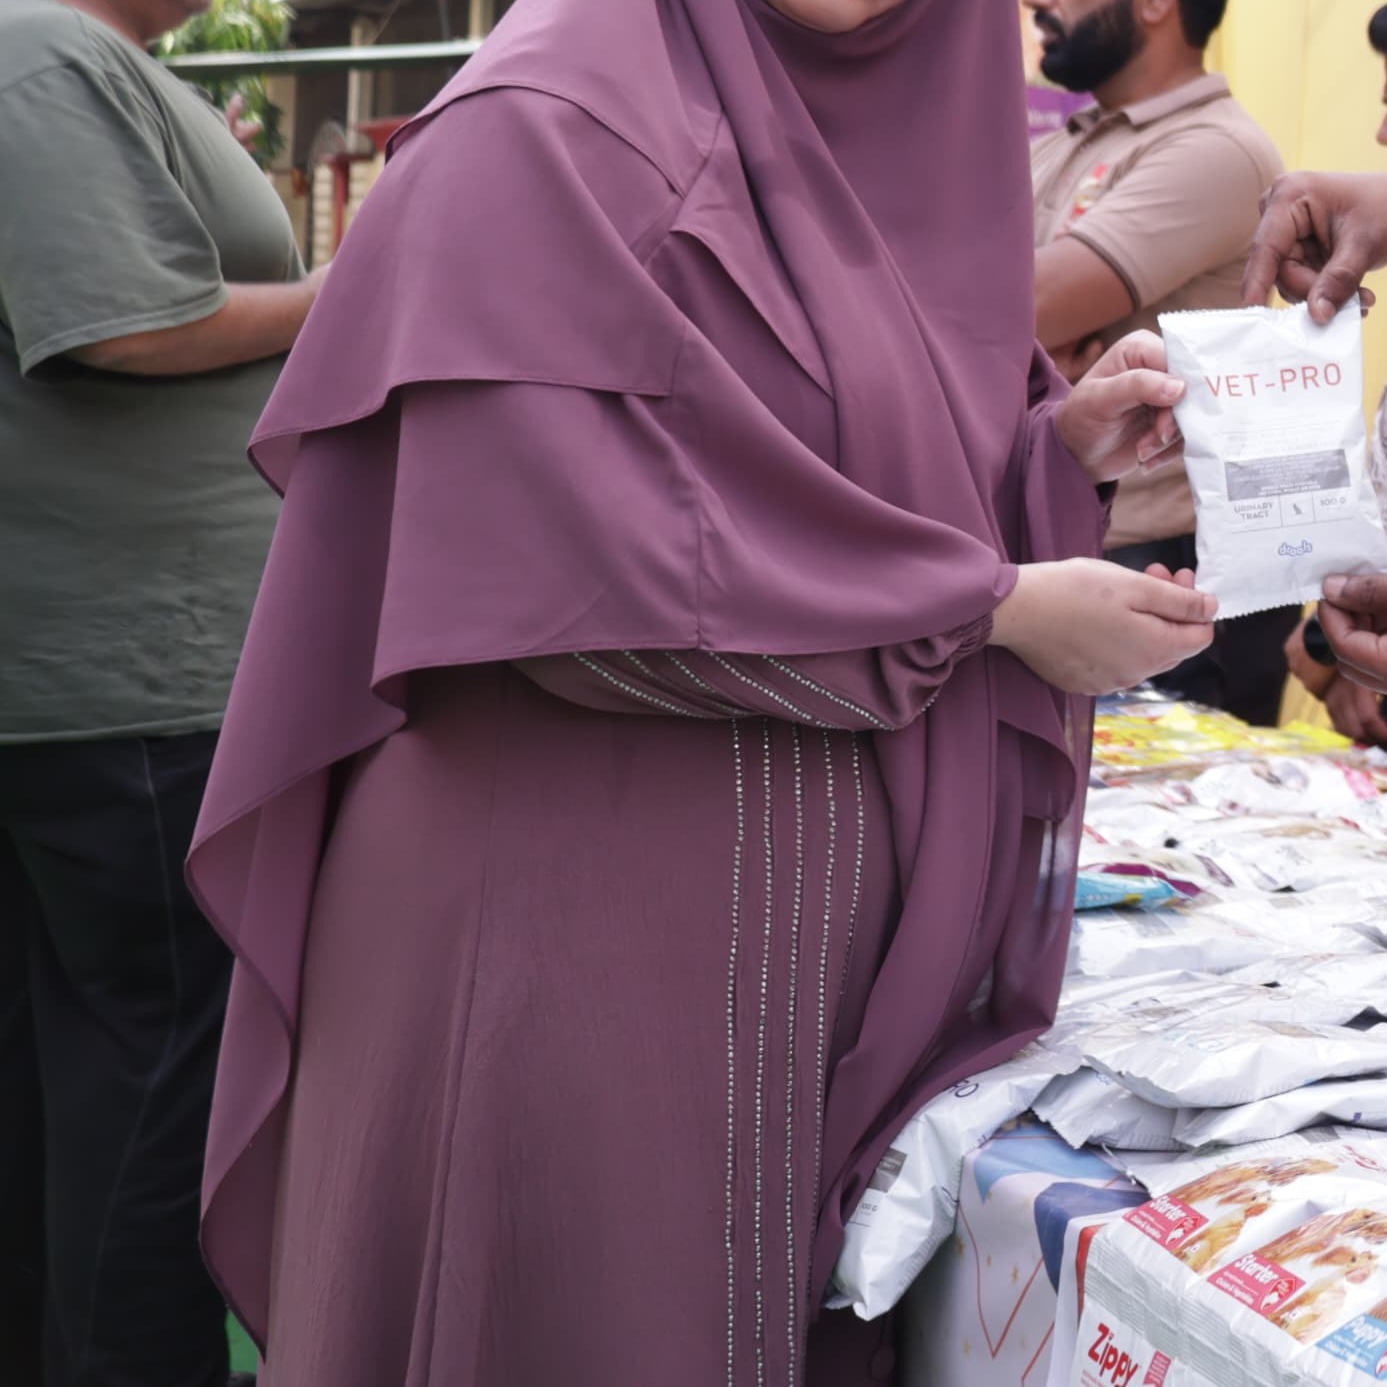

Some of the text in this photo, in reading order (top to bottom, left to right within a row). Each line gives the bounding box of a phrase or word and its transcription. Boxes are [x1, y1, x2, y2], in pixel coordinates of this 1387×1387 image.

[1205, 363, 1342, 398] VET-PRO
[1234, 502, 1273, 513] URINARY
[1150, 1195, 1187, 1221] Starter
[1235, 1254, 1280, 1284] Starter
[1088, 1322, 1138, 1387] Zippy
